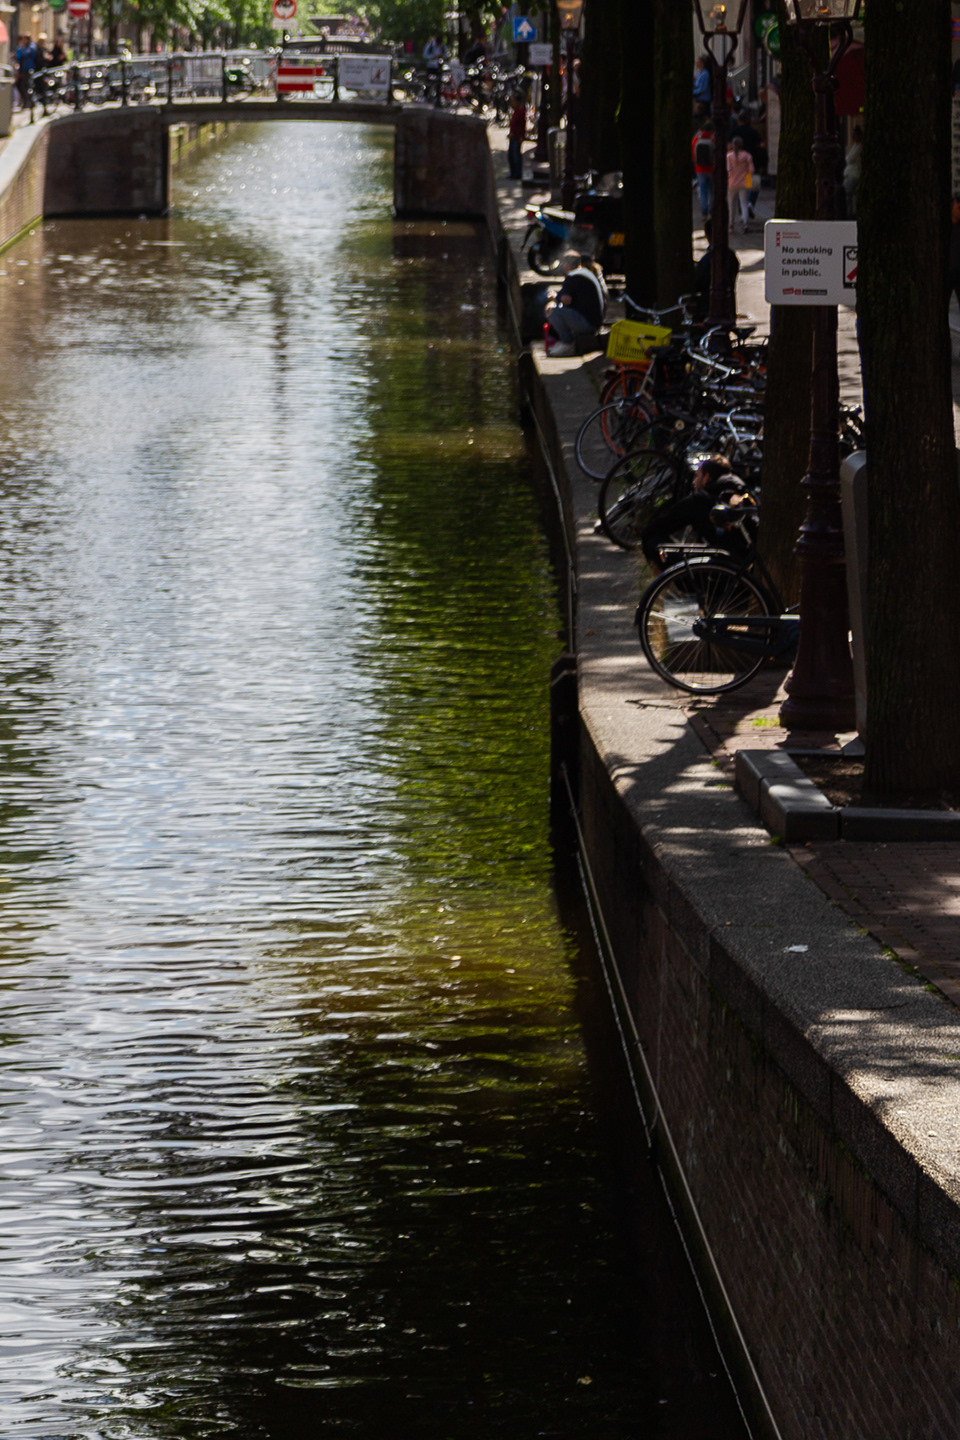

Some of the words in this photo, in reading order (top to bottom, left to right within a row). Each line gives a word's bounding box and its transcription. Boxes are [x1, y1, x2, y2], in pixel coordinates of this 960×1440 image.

[782, 246, 794, 254] No
[796, 246, 832, 256] smoking
[782, 257, 819, 265] cannabis
[782, 268, 790, 276] in
[792, 268, 821, 277] public.
